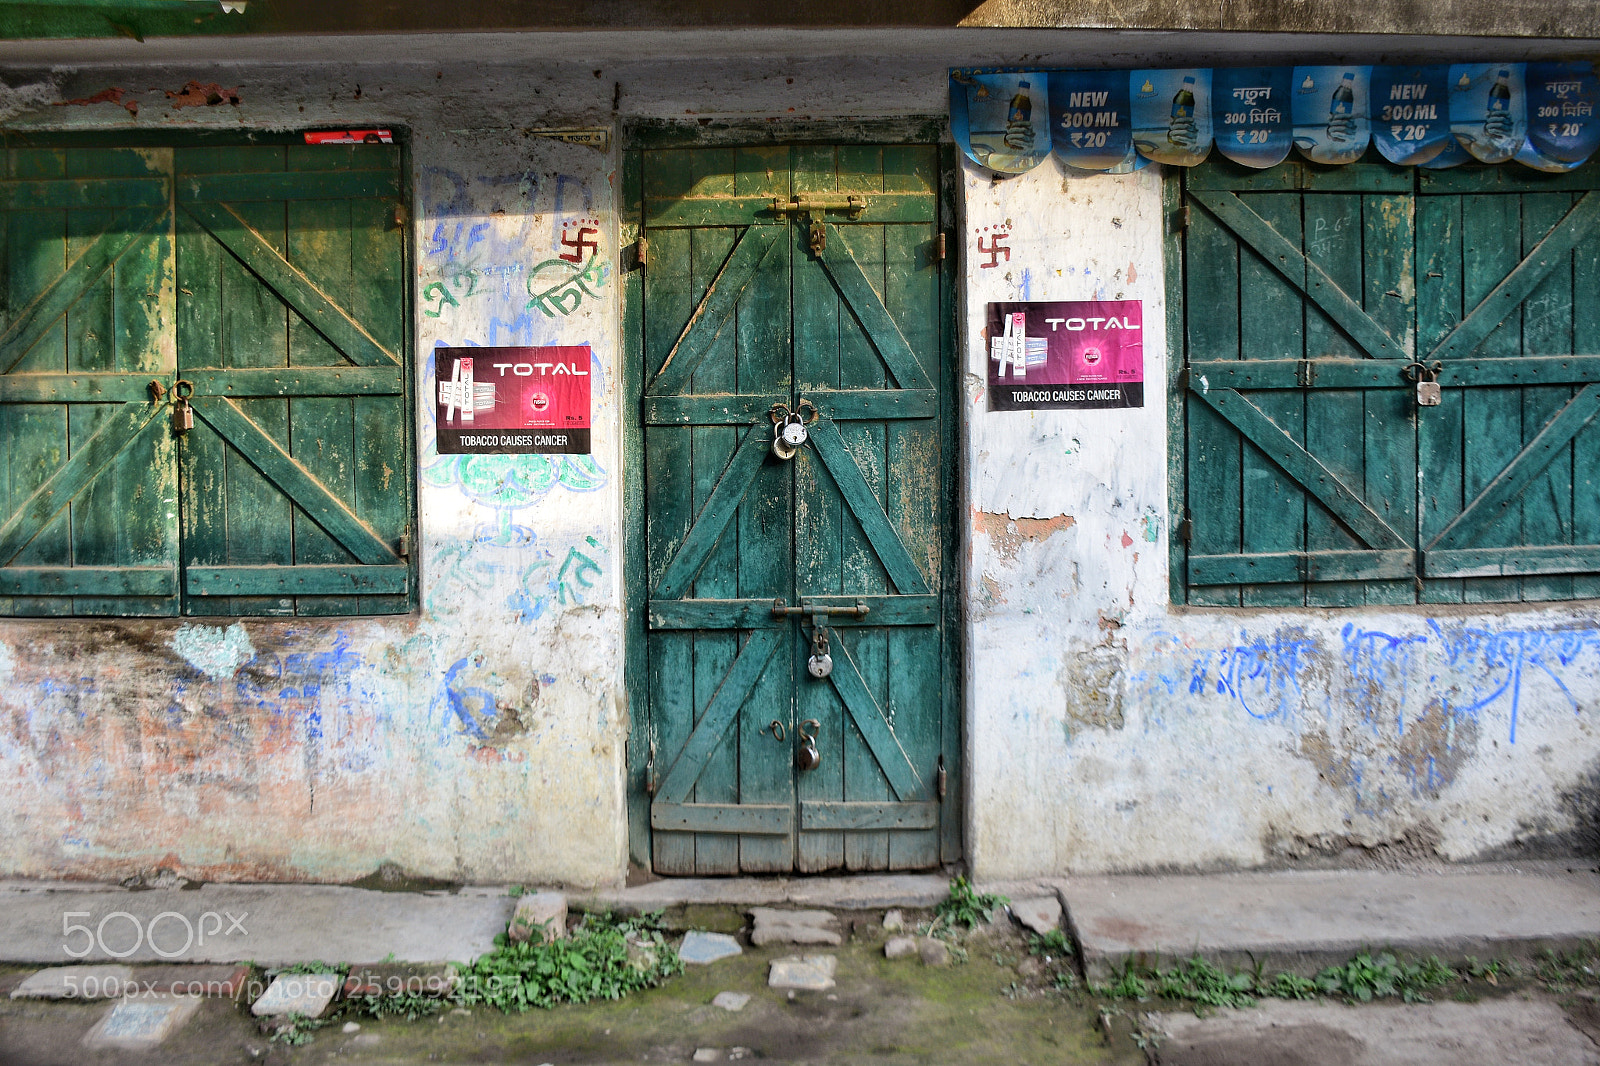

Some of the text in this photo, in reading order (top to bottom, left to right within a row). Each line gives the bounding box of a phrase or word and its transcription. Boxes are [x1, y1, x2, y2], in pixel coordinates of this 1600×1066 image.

[1232, 87, 1272, 106] নতুন
[1390, 84, 1428, 101] NEW
[1544, 81, 1582, 99] নতুন
[1069, 91, 1109, 108] NEW
[1224, 108, 1282, 125] 300 মিলি
[1537, 106, 1560, 118] 300
[1044, 316, 1141, 331] TOTAL
[493, 362, 589, 377] TOTAL
[1012, 389, 1121, 403] TOBACCO CAUSES CANCER
[460, 435, 568, 447] TOBACCO CAUSES CANCER
